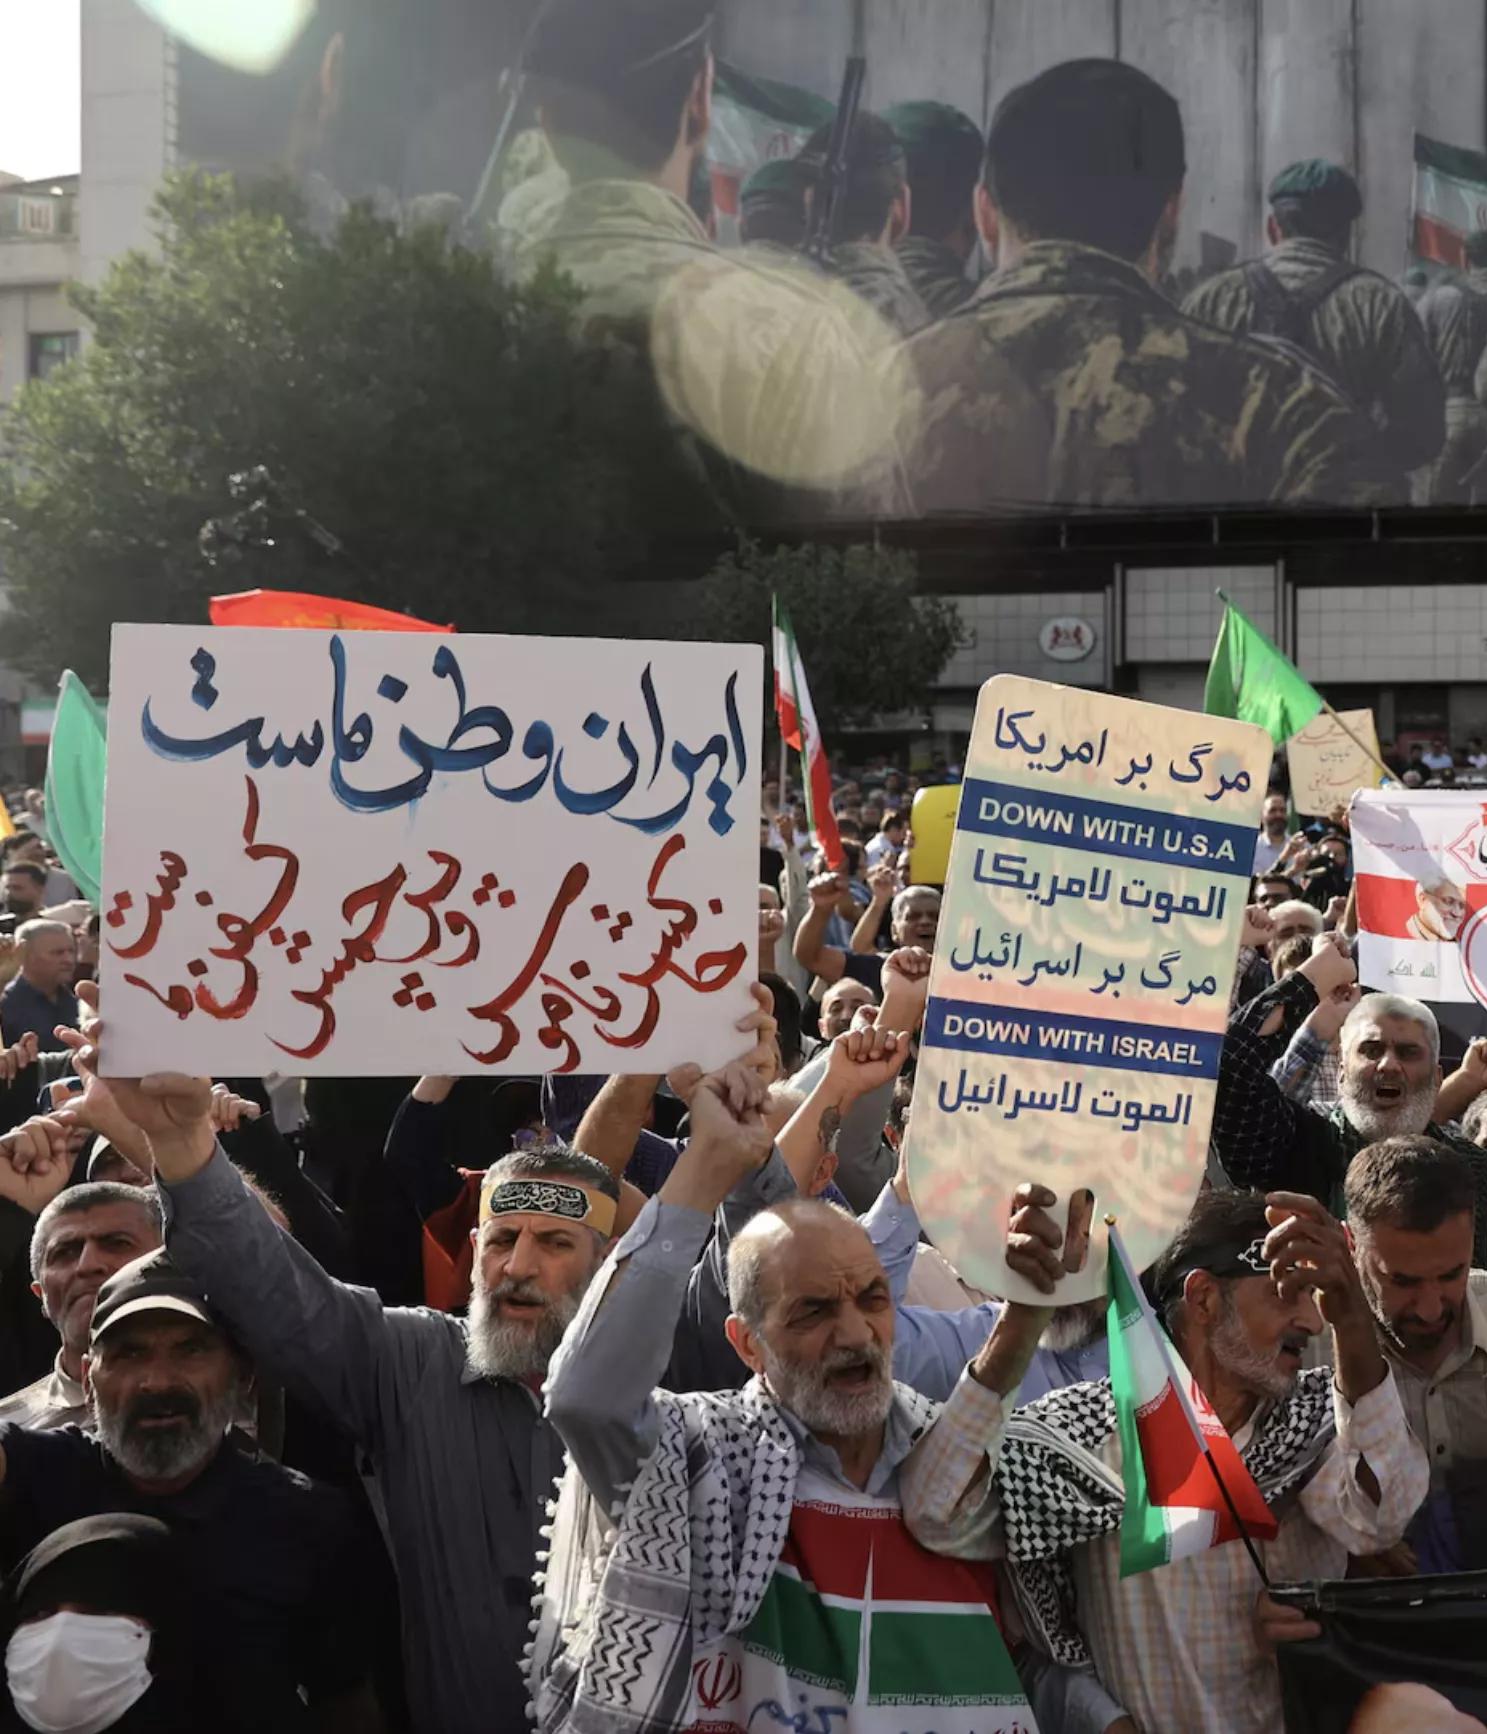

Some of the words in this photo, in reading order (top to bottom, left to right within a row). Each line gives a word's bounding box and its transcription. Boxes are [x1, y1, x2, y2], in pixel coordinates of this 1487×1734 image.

[141, 634, 374, 769] ماست
[329, 645, 555, 814] وطن
[553, 661, 748, 836] ایران
[994, 707, 1109, 771] امریکا
[1115, 746, 1154, 790] بر
[1169, 742, 1252, 800] مرگ
[978, 797, 1075, 839] DOWN
[1082, 815, 1155, 850] WITH
[1162, 828, 1237, 862] U.S.A
[1120, 879, 1227, 923] الموت
[1090, 960, 1125, 1000] بر
[1139, 950, 1218, 1005] مرگ
[942, 1014, 1031, 1051] DOWN
[1038, 1028, 1105, 1060] WITH
[1111, 1037, 1204, 1066] ISRAEL
[1090, 1090, 1193, 1131] الموت
